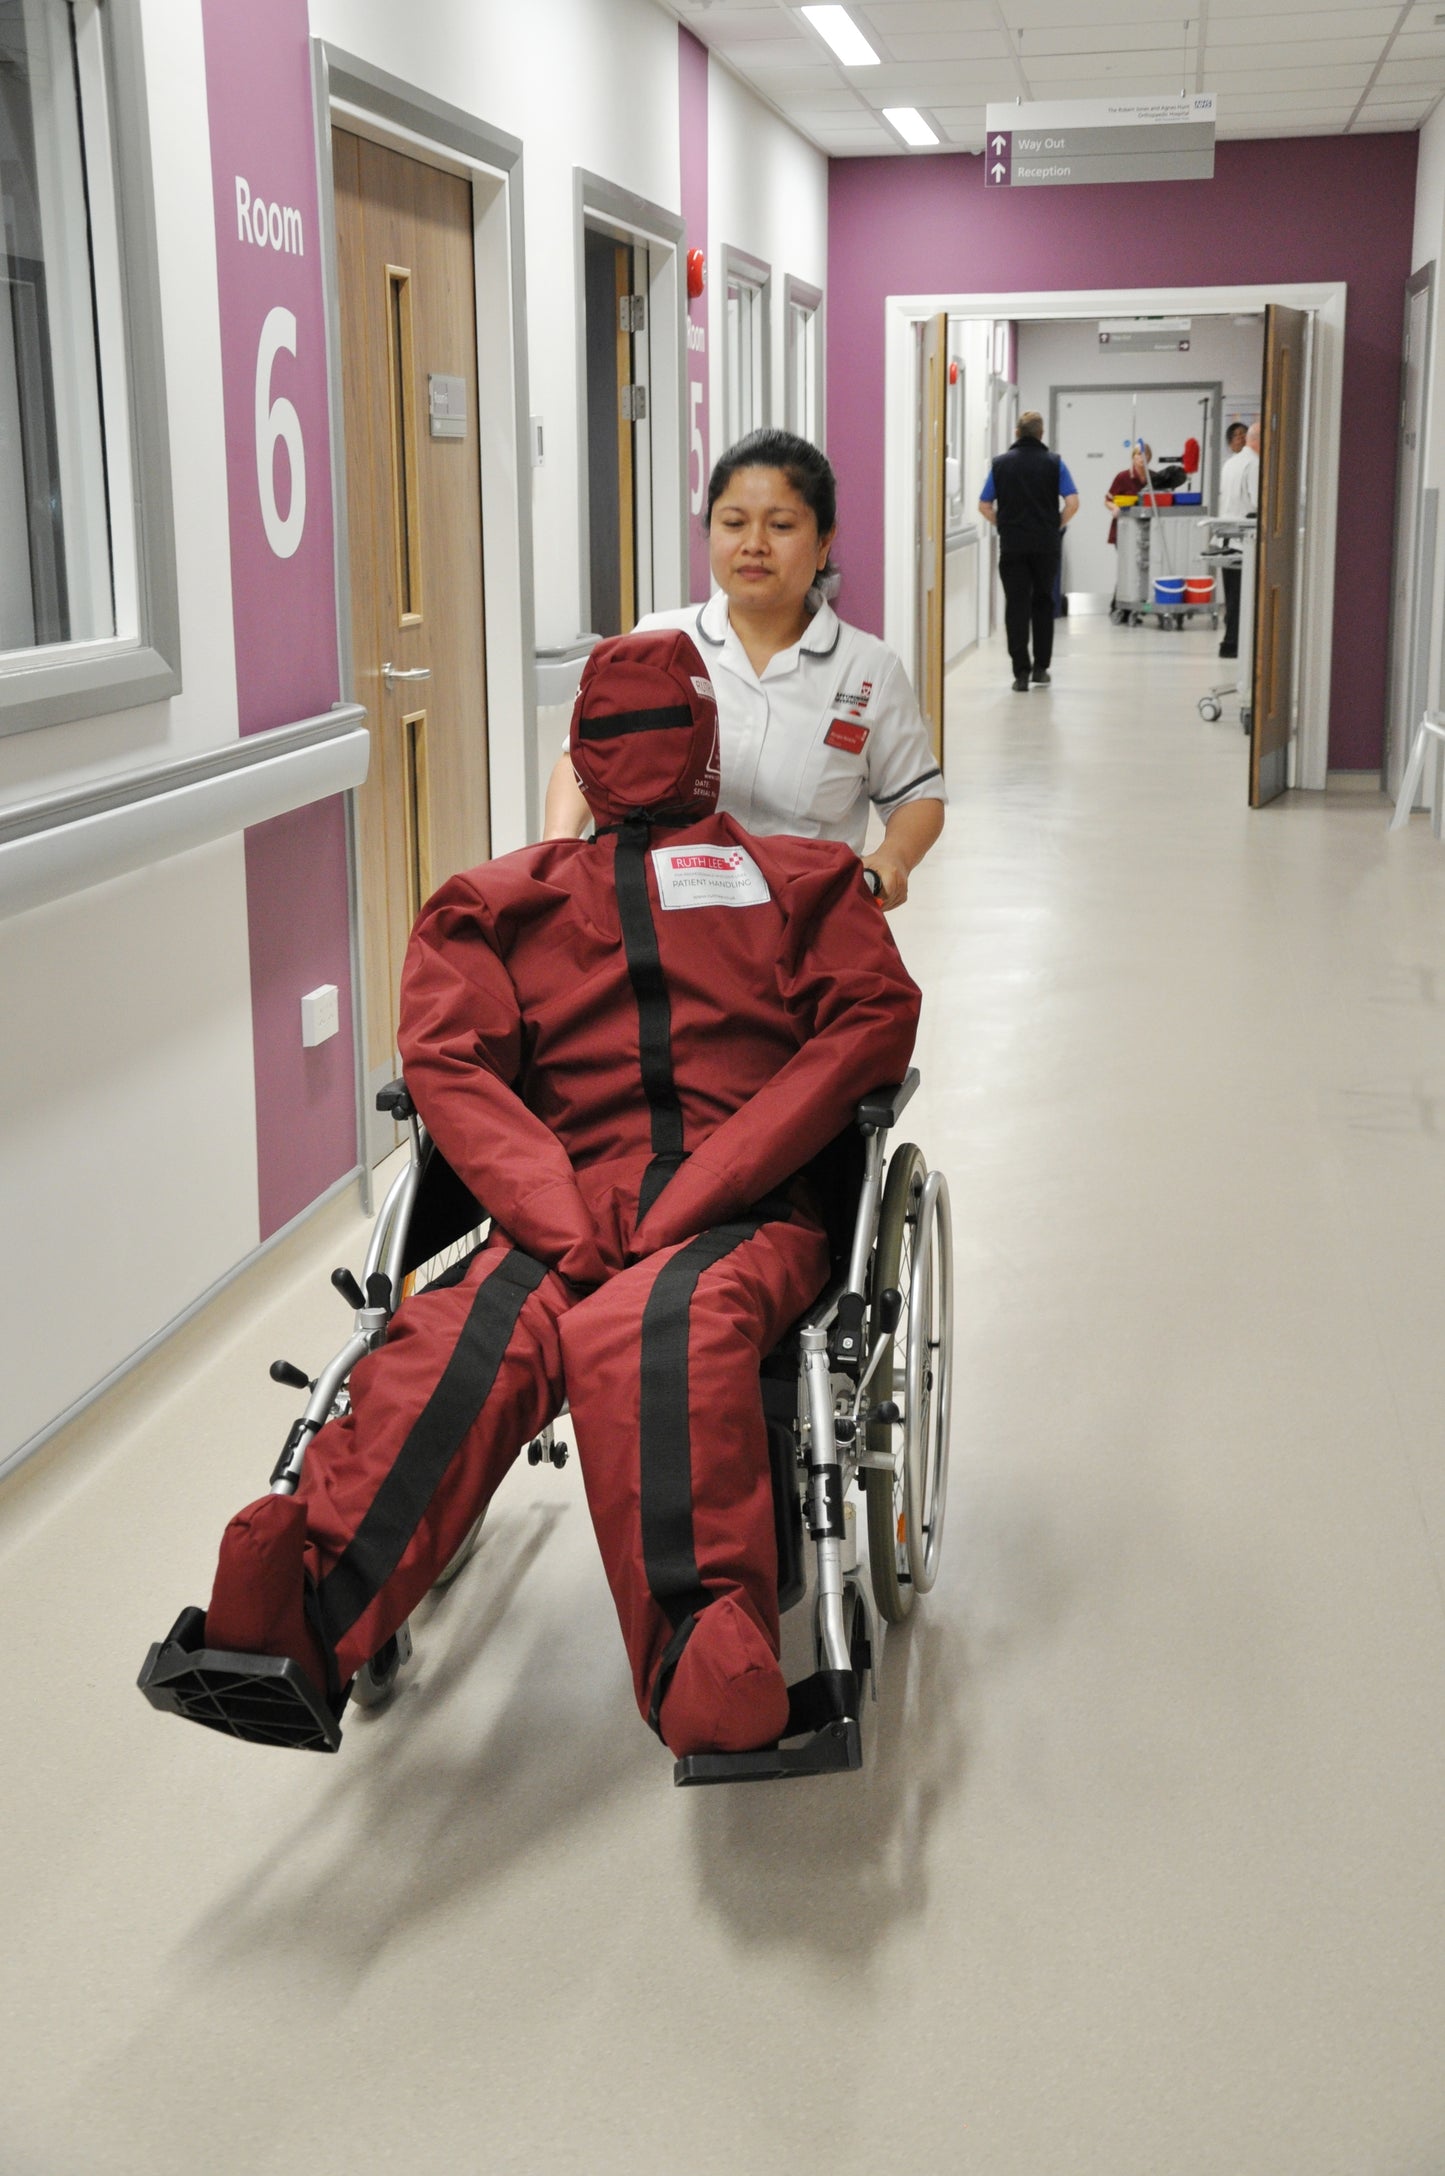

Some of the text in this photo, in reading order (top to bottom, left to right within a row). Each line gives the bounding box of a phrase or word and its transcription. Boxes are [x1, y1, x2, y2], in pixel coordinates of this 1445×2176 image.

[1194, 100, 1212, 109] NHS
[1018, 138, 1066, 152] Way Out
[1017, 166, 1071, 180] Reception
[235, 175, 304, 256] Room
[255, 306, 306, 559] 6
[690, 381, 704, 516] 5
[676, 857, 723, 869] RUTH LEE
[672, 879, 752, 888] PATIENT HANDLING
